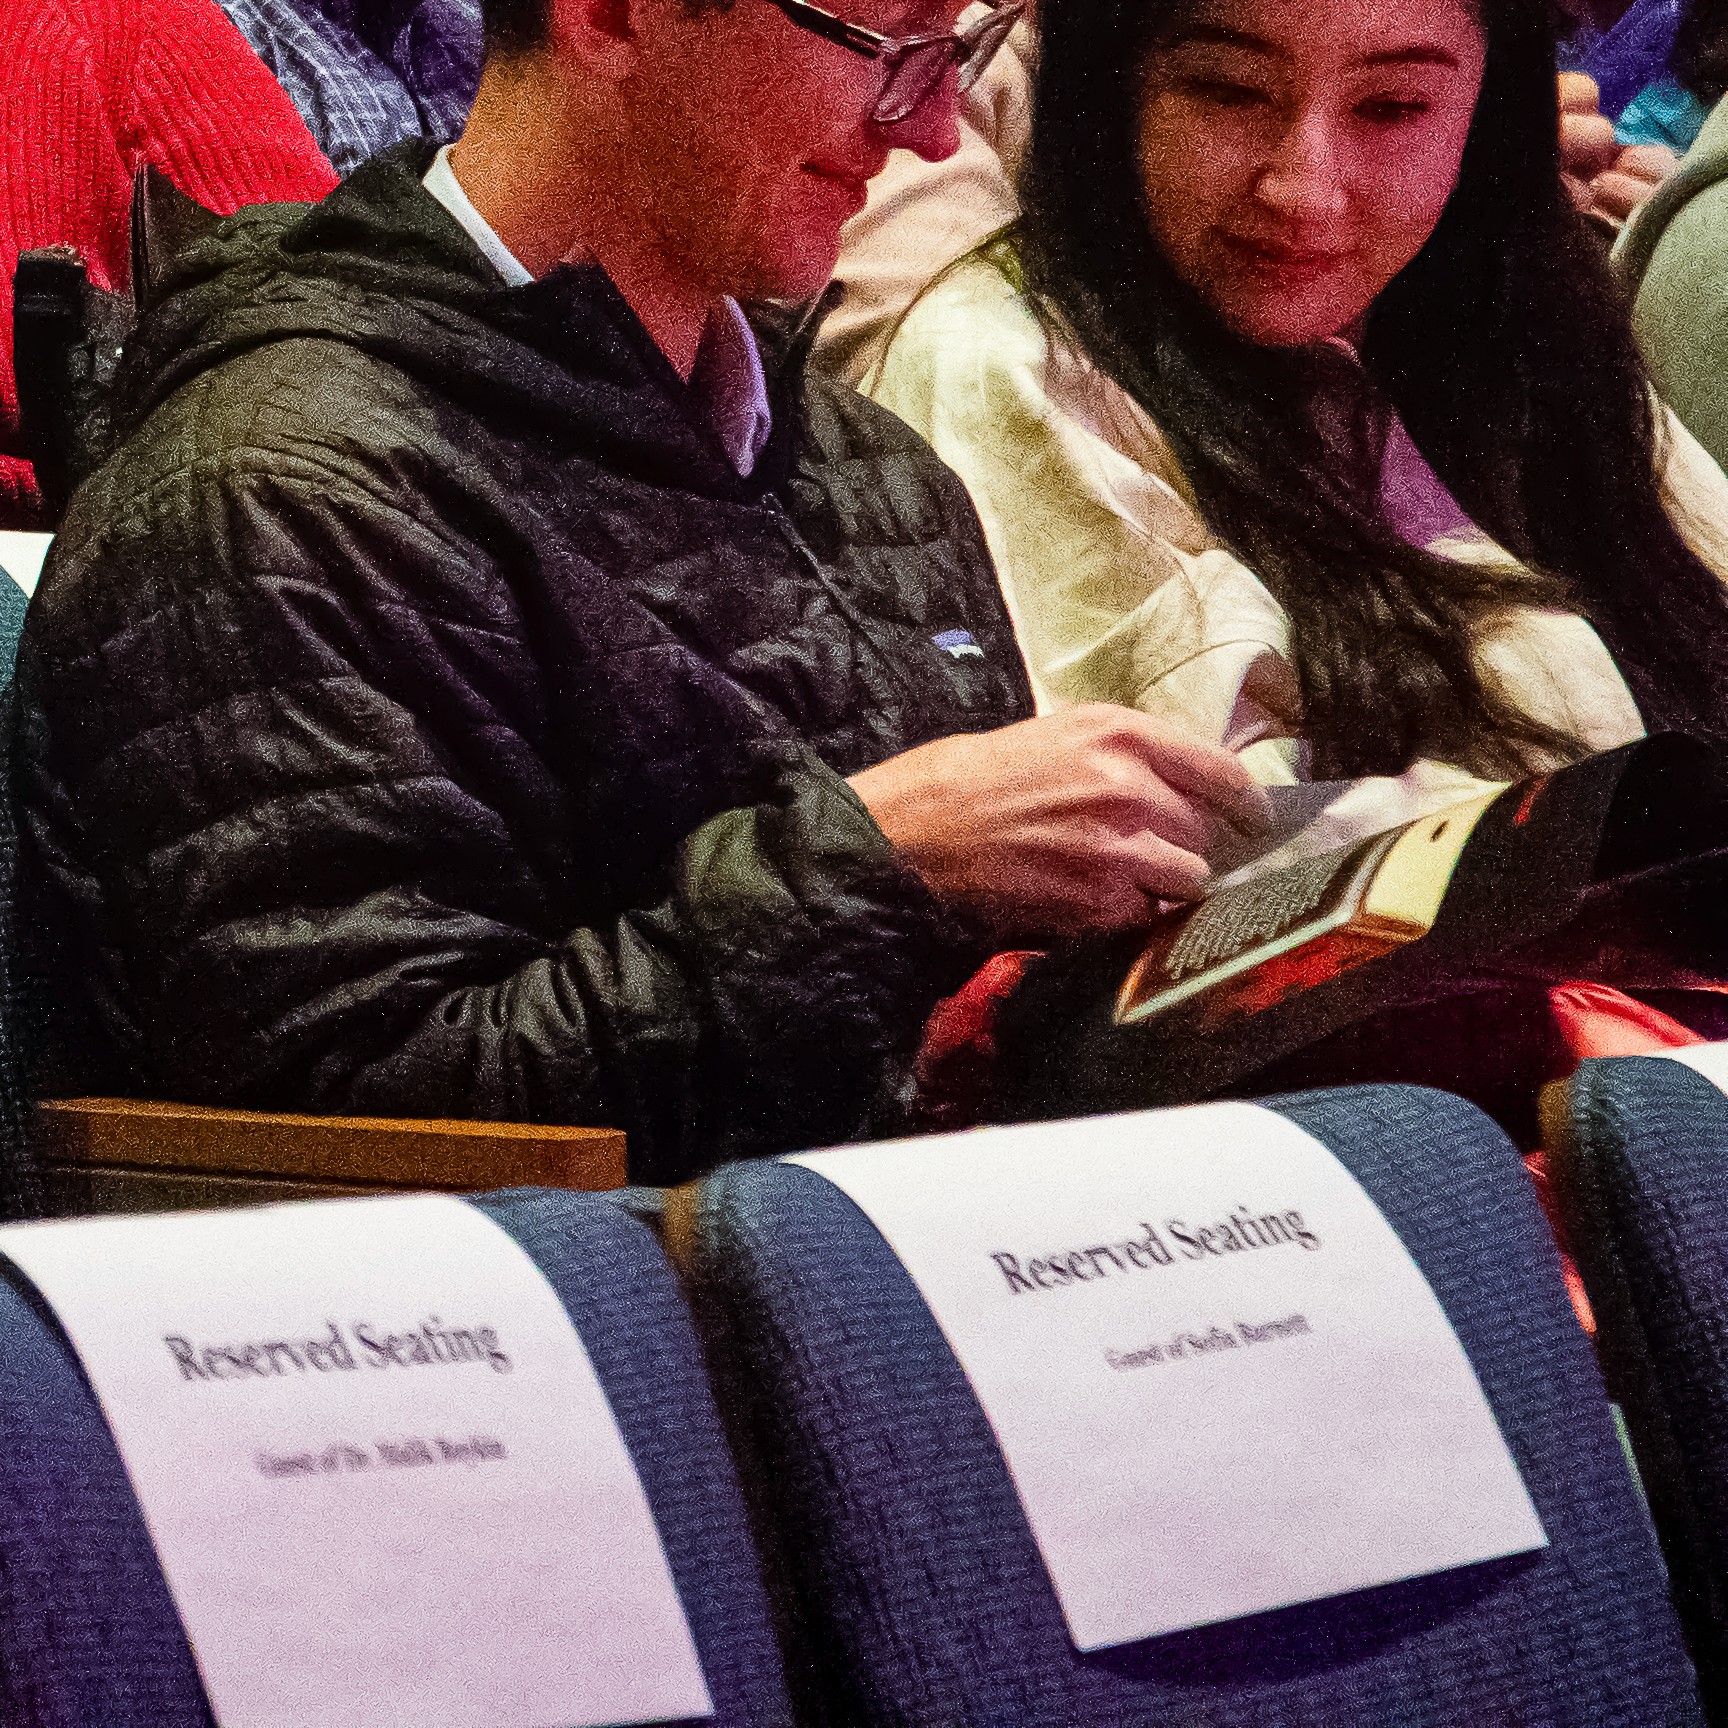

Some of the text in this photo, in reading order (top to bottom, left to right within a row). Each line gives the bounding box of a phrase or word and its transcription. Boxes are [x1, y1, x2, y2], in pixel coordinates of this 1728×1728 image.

[989, 1205, 1319, 1294] Reserved Seating
[163, 1314, 512, 1381] Reserved Seating
